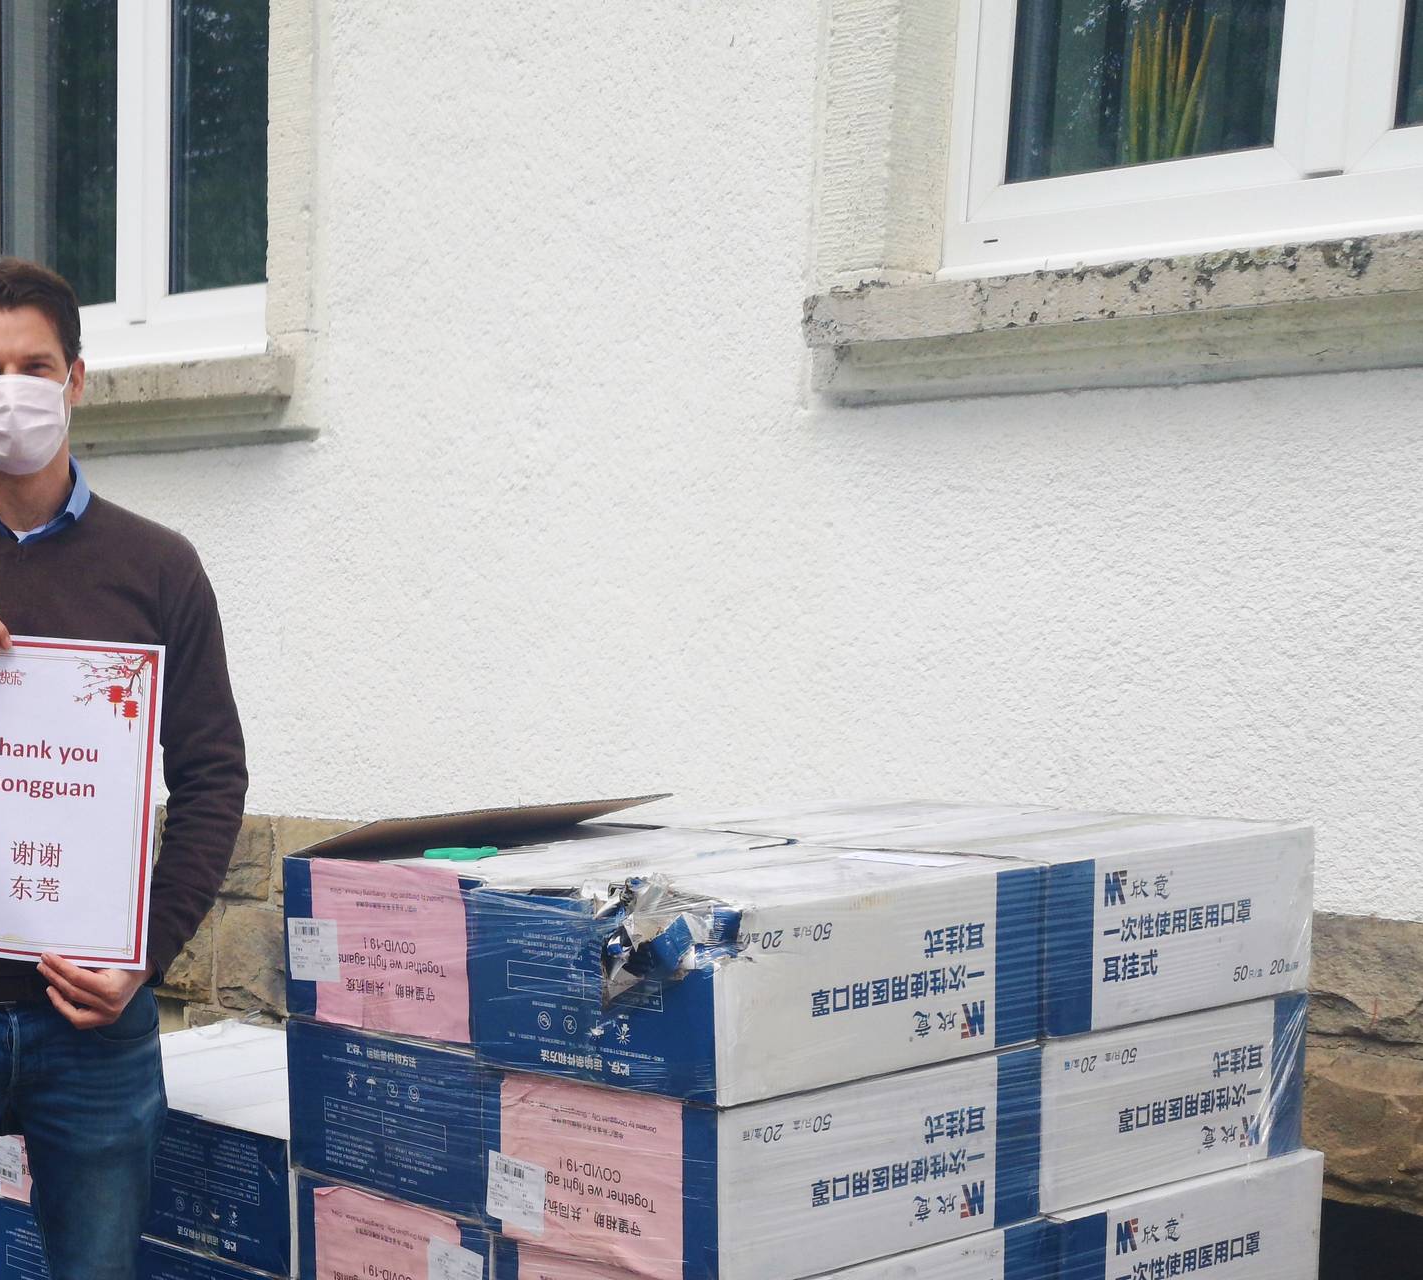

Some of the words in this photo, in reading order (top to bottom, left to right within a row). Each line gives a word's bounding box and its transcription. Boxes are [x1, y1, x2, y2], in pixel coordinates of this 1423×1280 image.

[58, 745, 98, 764] you
[10, 841, 63, 868] 谢谢
[9, 875, 60, 902] 东莞
[1103, 899, 1252, 942] 一次性使用医用口罩
[924, 922, 985, 958] 耳挂式
[339, 952, 367, 968] agains
[368, 956, 387, 970] fight
[390, 960, 403, 969] we
[407, 960, 446, 977] Together
[1103, 949, 1158, 983] 耳挂式
[811, 964, 985, 1017] 一次性使用医用口罩
[1213, 1044, 1264, 1078] 耳挂式
[1119, 1083, 1262, 1133] 一次性使用医用口罩
[924, 1106, 986, 1144] 耳挂式
[563, 1178, 584, 1195] fight
[588, 1184, 604, 1198] we
[811, 1148, 985, 1207] 一次性使用医用口罩
[606, 1190, 656, 1213] Together
[545, 1198, 642, 1237] 守望相助，共同抗
